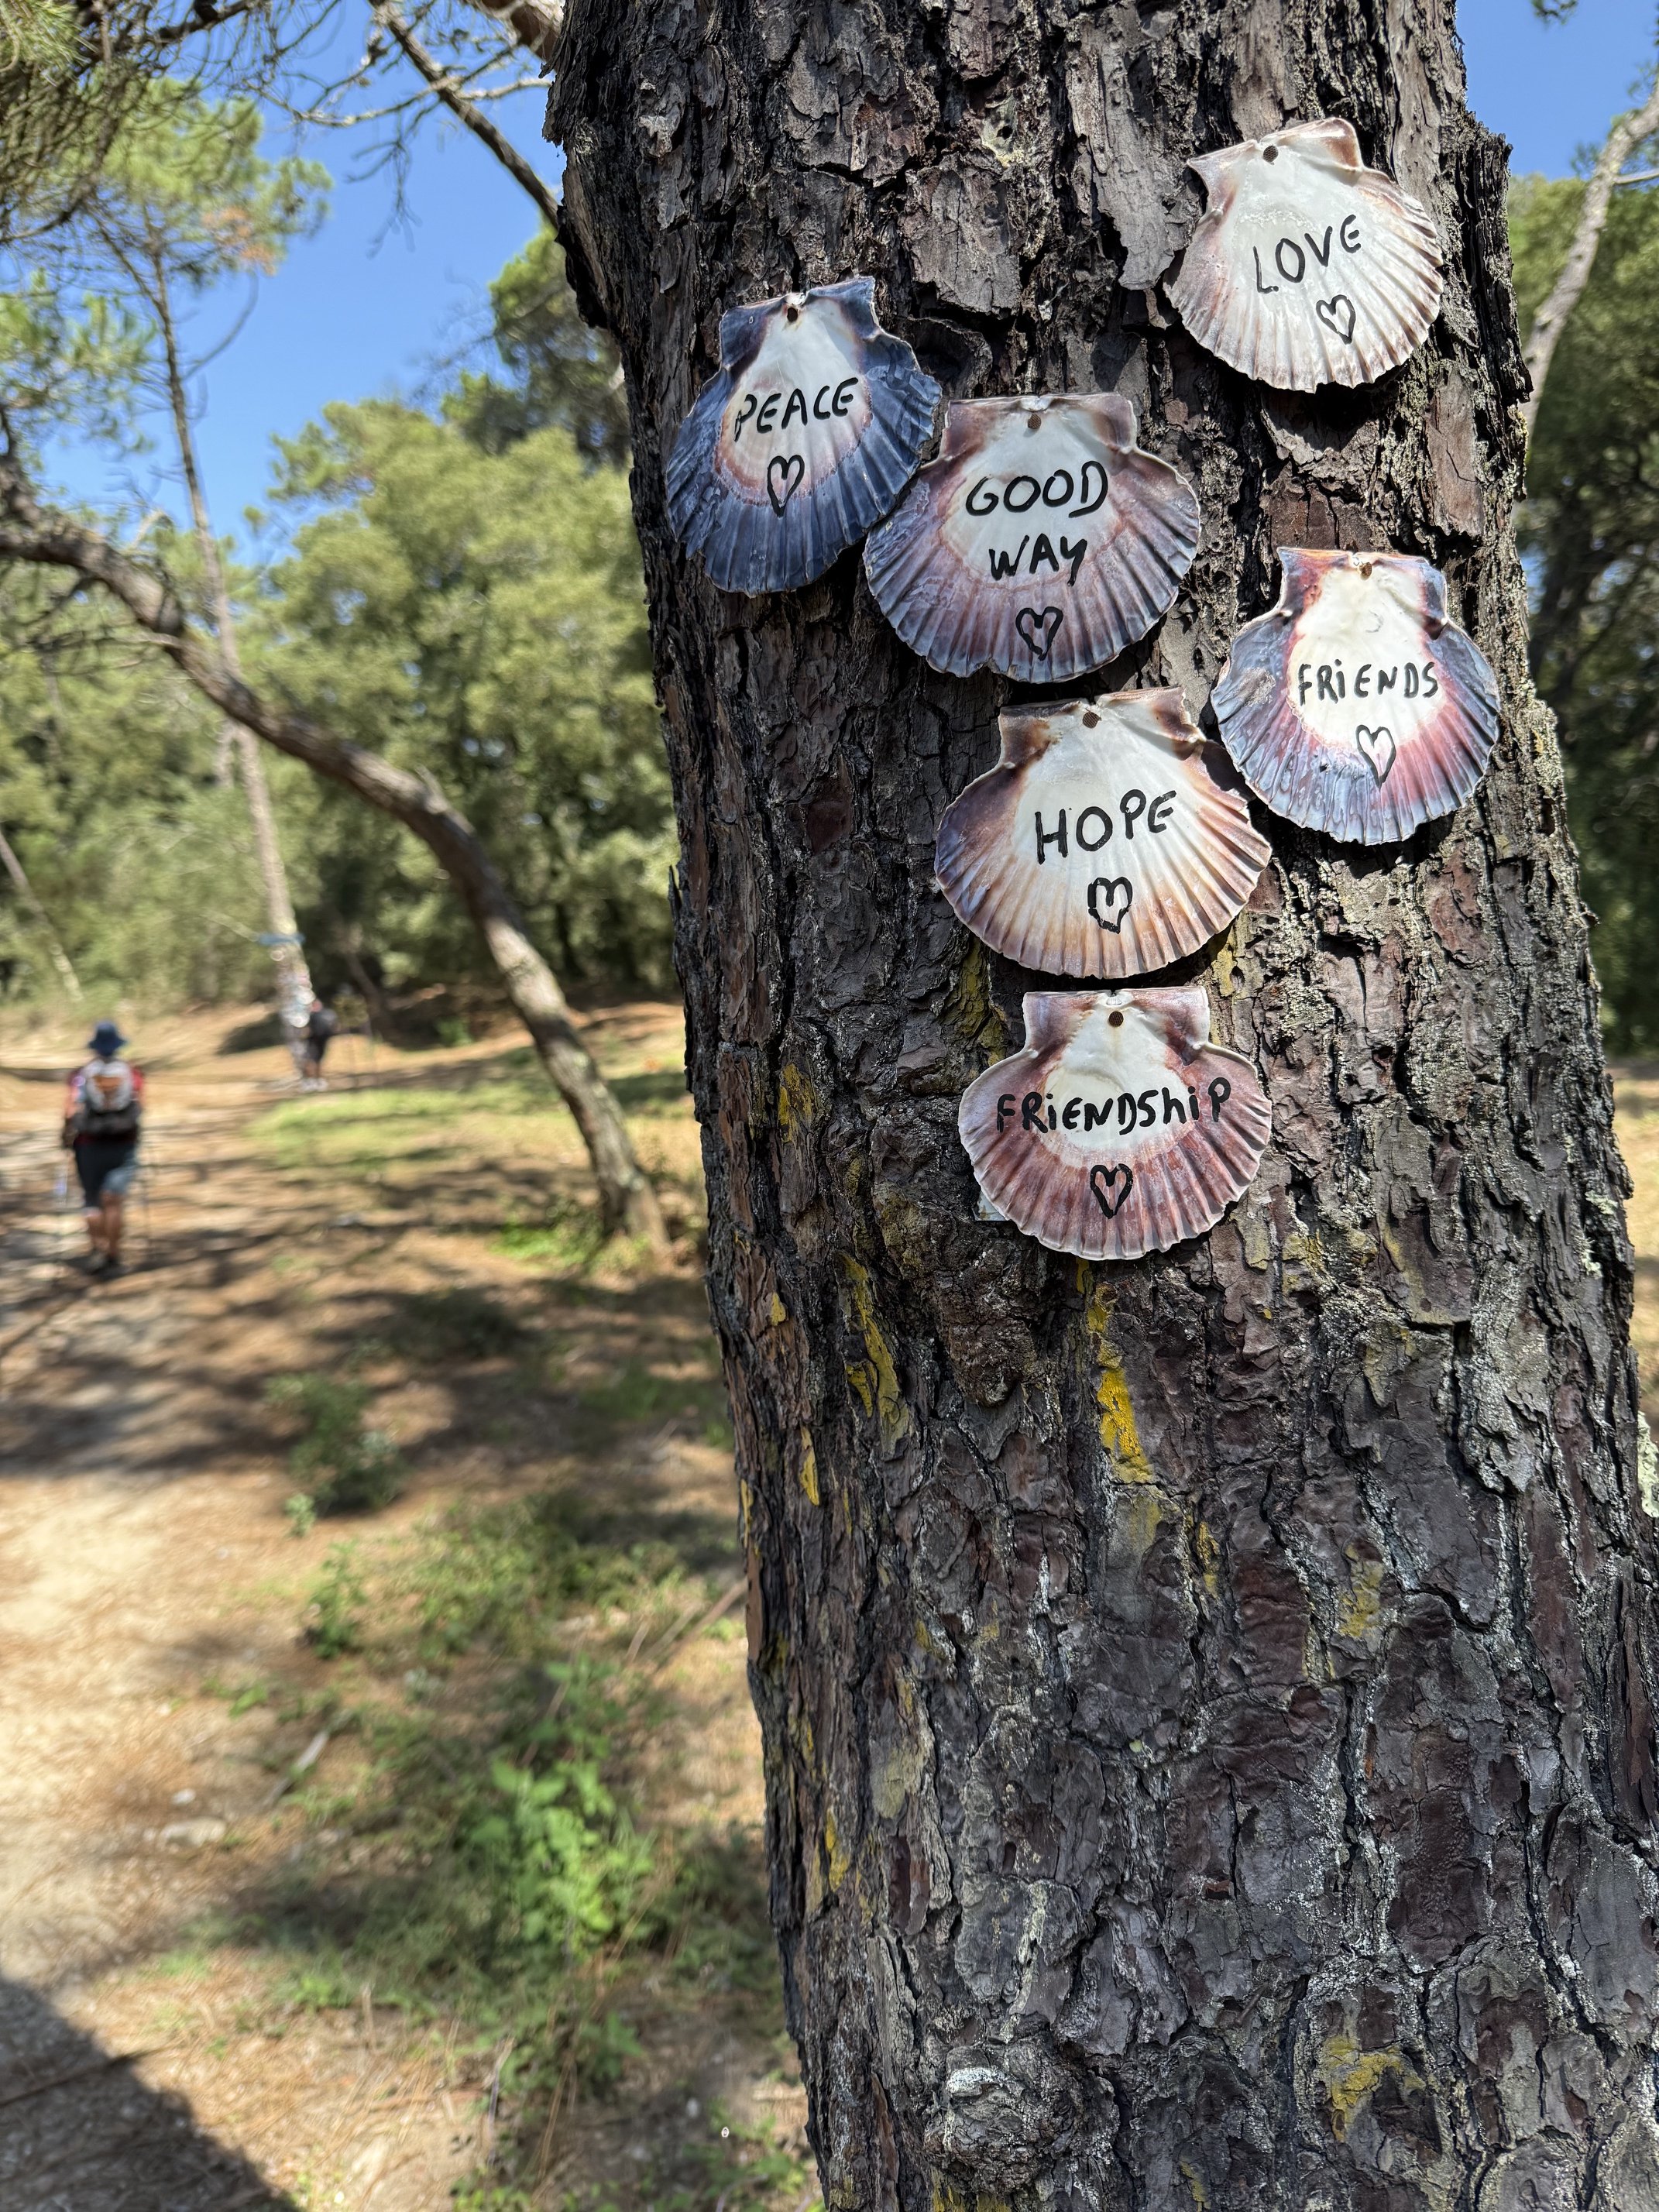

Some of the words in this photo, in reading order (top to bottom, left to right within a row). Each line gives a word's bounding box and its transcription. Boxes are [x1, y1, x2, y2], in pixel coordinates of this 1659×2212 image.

[1253, 215, 1361, 294] LOVE
[734, 377, 858, 442] PEACE
[966, 461, 1108, 518] GOOD
[988, 533, 1087, 587] WAY
[1035, 788, 1176, 864] HOPE
